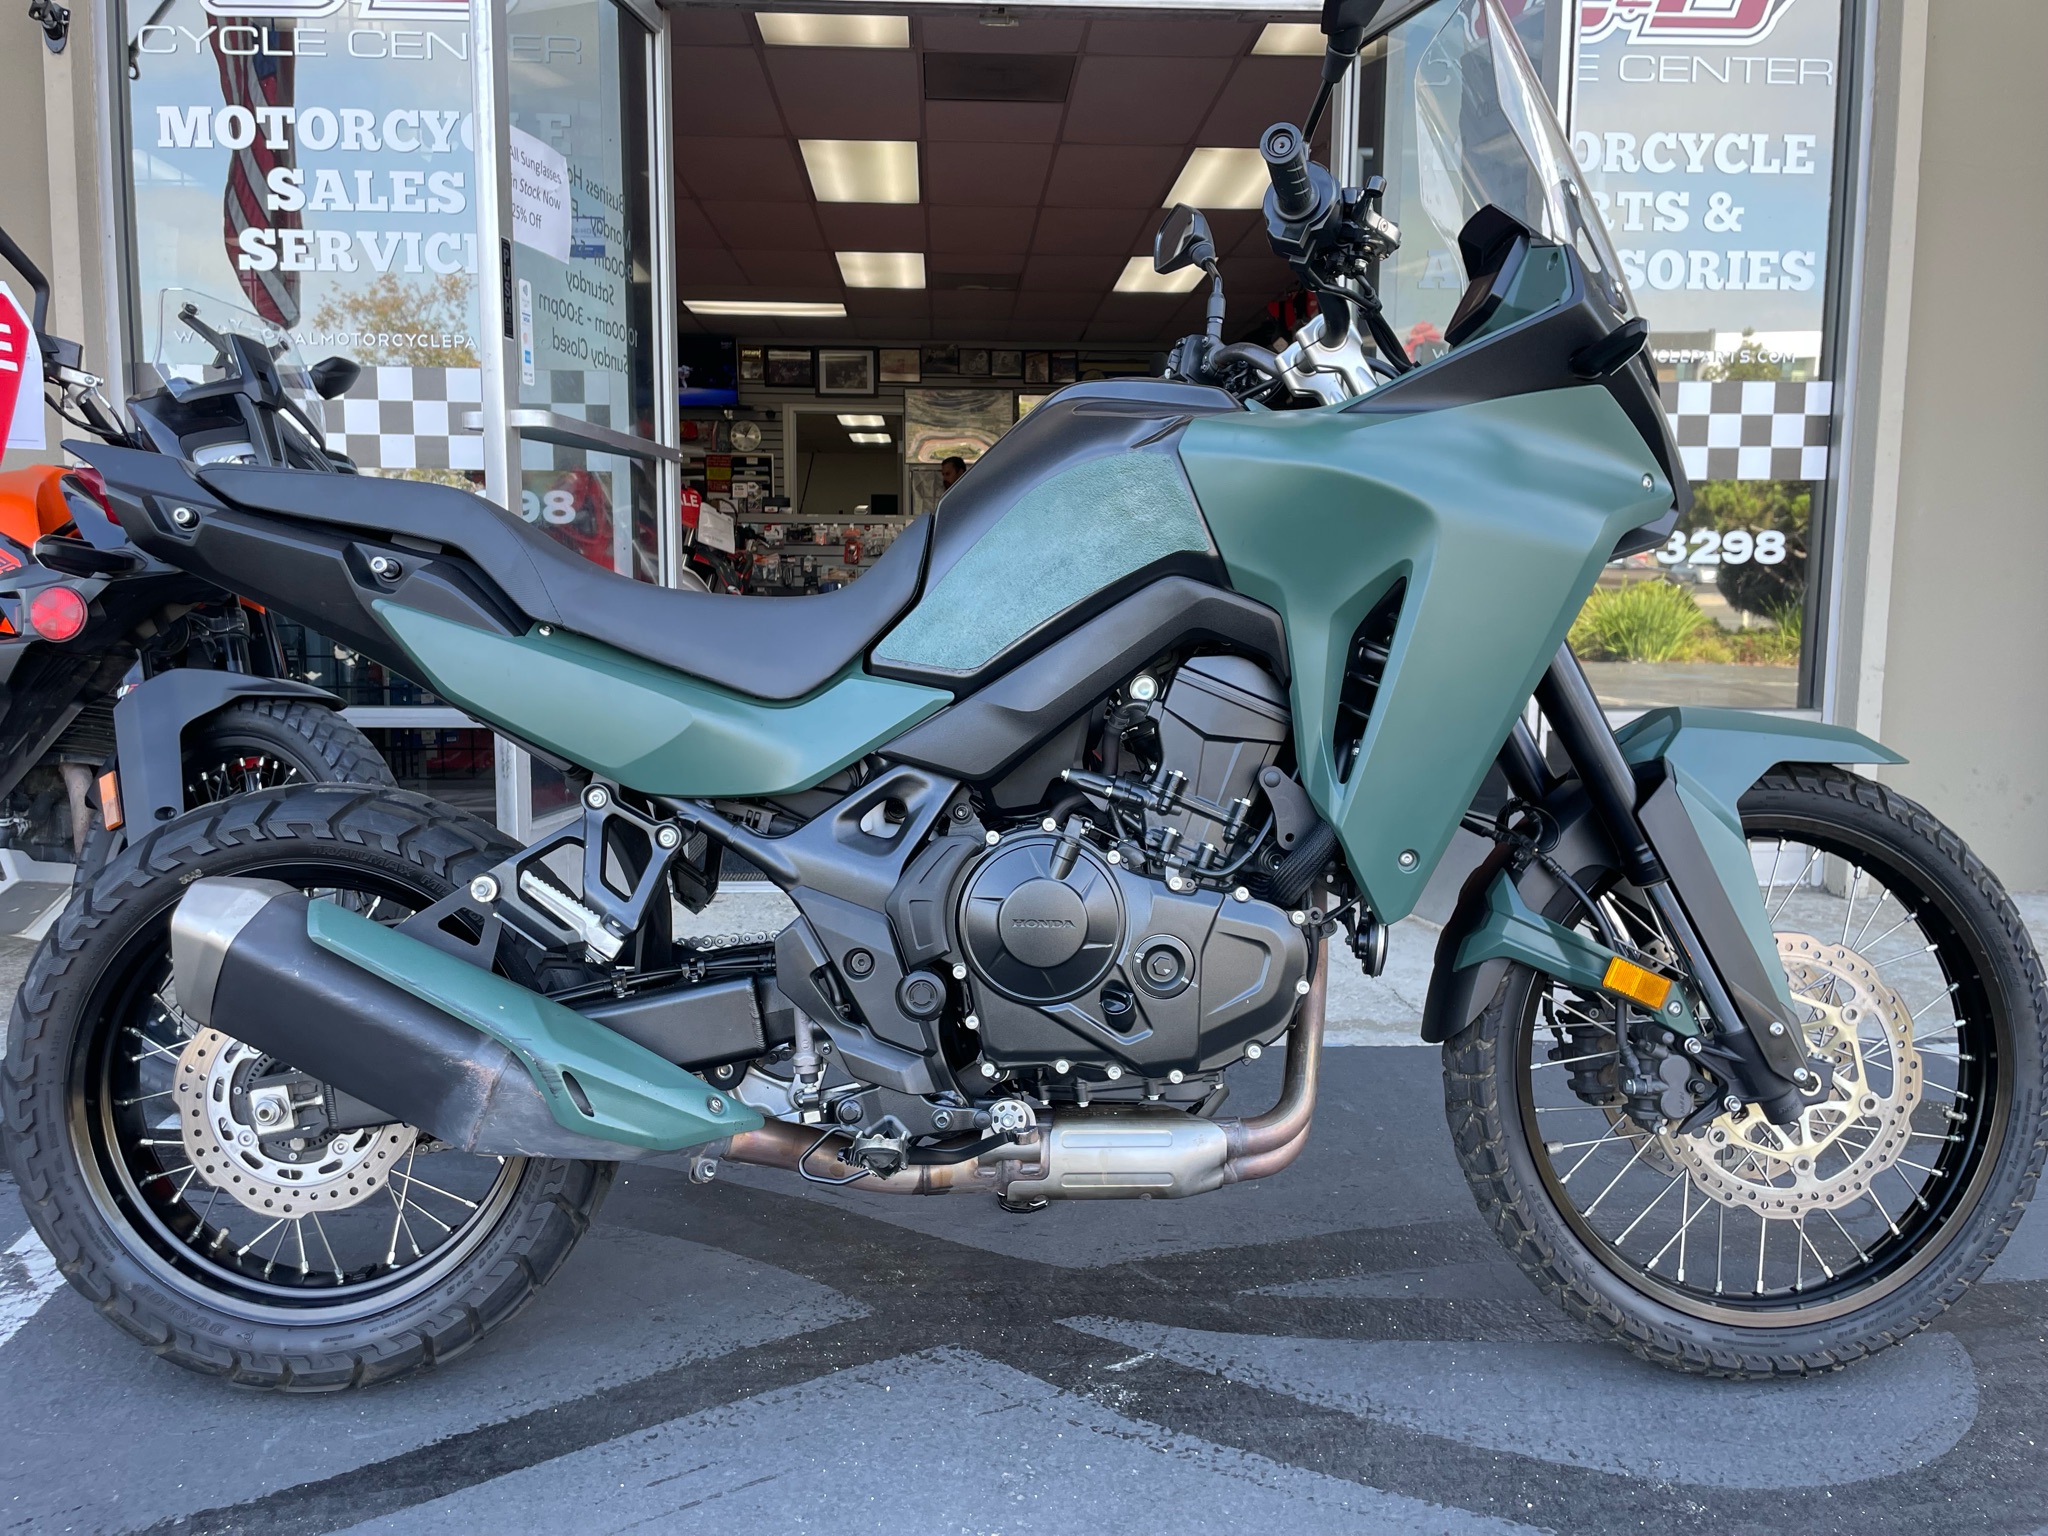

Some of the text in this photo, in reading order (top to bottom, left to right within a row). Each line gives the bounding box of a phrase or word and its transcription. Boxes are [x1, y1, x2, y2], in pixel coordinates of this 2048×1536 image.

[137, 25, 328, 58] CYCLE
[1618, 54, 1834, 86] CENTER
[520, 151, 563, 185] Sunglasses
[1573, 130, 1815, 175] ORCYCLE
[267, 166, 467, 214] SALES
[519, 178, 542, 201] Stock
[542, 190, 562, 210] Now
[529, 211, 543, 229] Off
[1703, 190, 1745, 233] &
[502, 251, 513, 315] PUSH
[1656, 529, 1787, 565] 3298
[1011, 918, 1076, 929] HONDA
